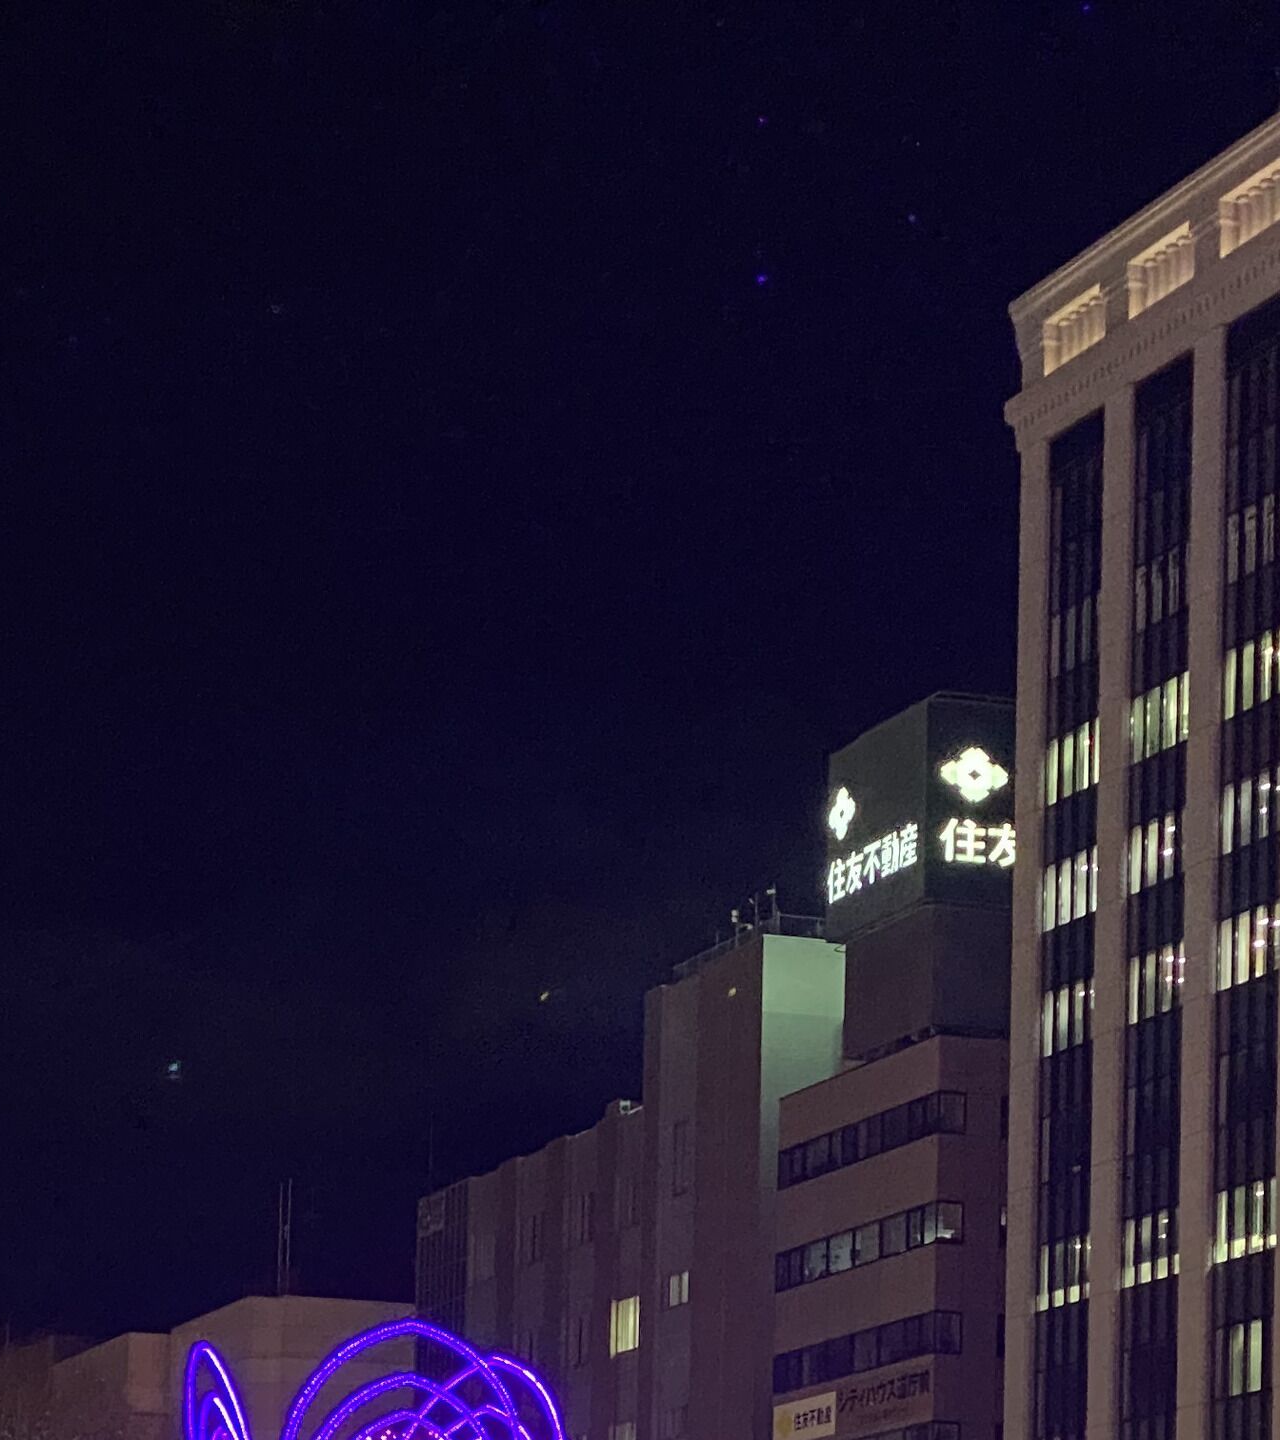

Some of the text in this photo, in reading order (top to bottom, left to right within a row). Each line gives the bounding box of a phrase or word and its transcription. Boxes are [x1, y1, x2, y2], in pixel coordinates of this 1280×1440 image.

[827, 823, 918, 904] 住友不動産
[795, 1405, 832, 1432] 住友不動産
